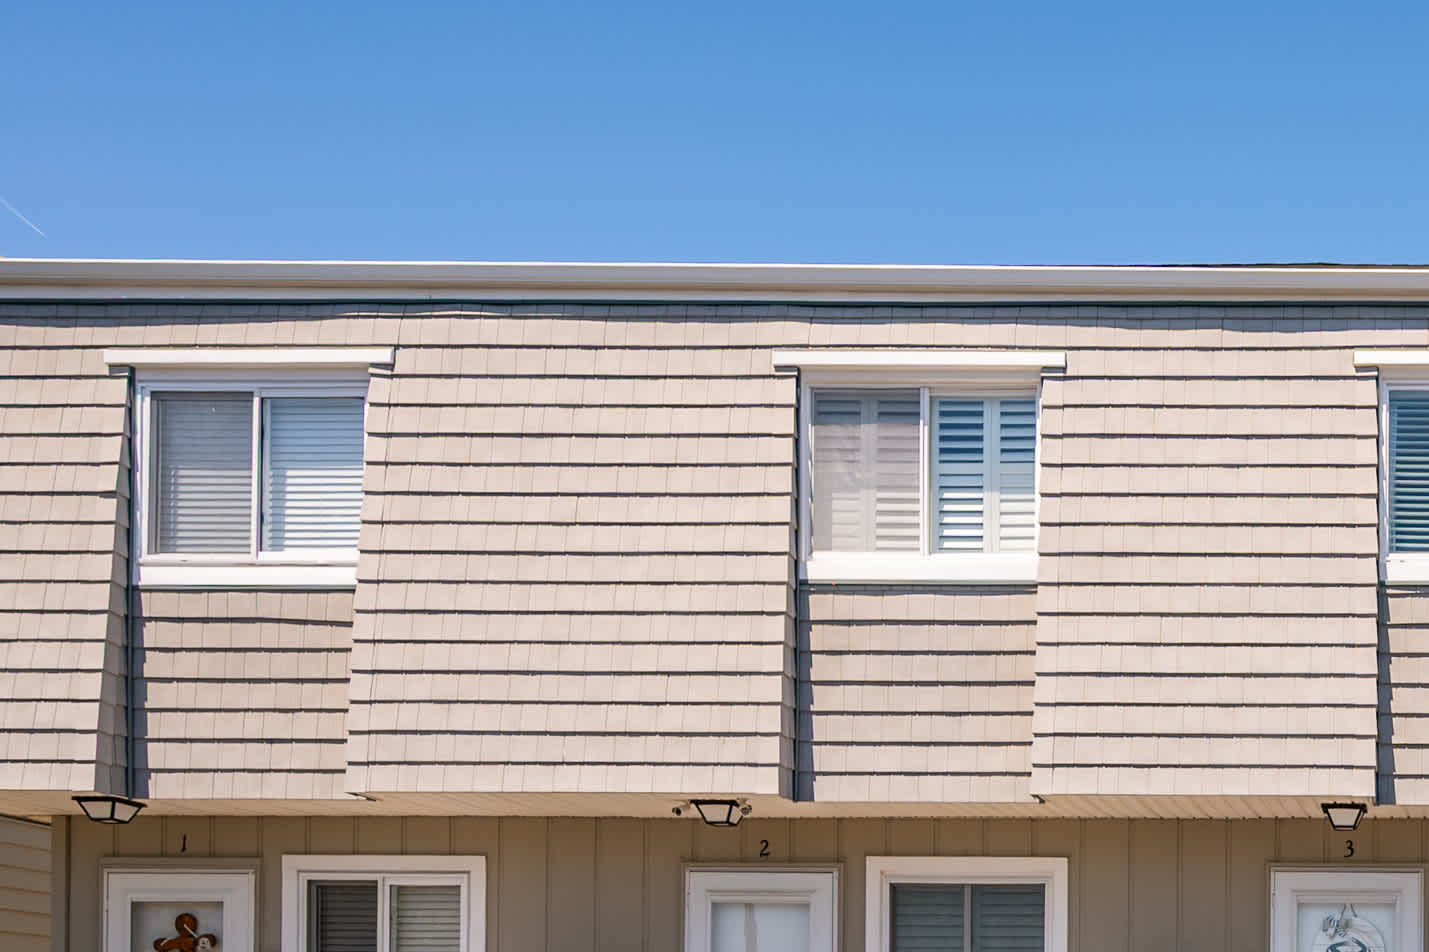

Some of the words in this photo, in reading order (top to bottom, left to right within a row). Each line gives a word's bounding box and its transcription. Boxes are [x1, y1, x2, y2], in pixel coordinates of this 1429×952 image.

[180, 834, 187, 853] 1
[759, 839, 771, 857] 2
[1343, 839, 1355, 857] 3
